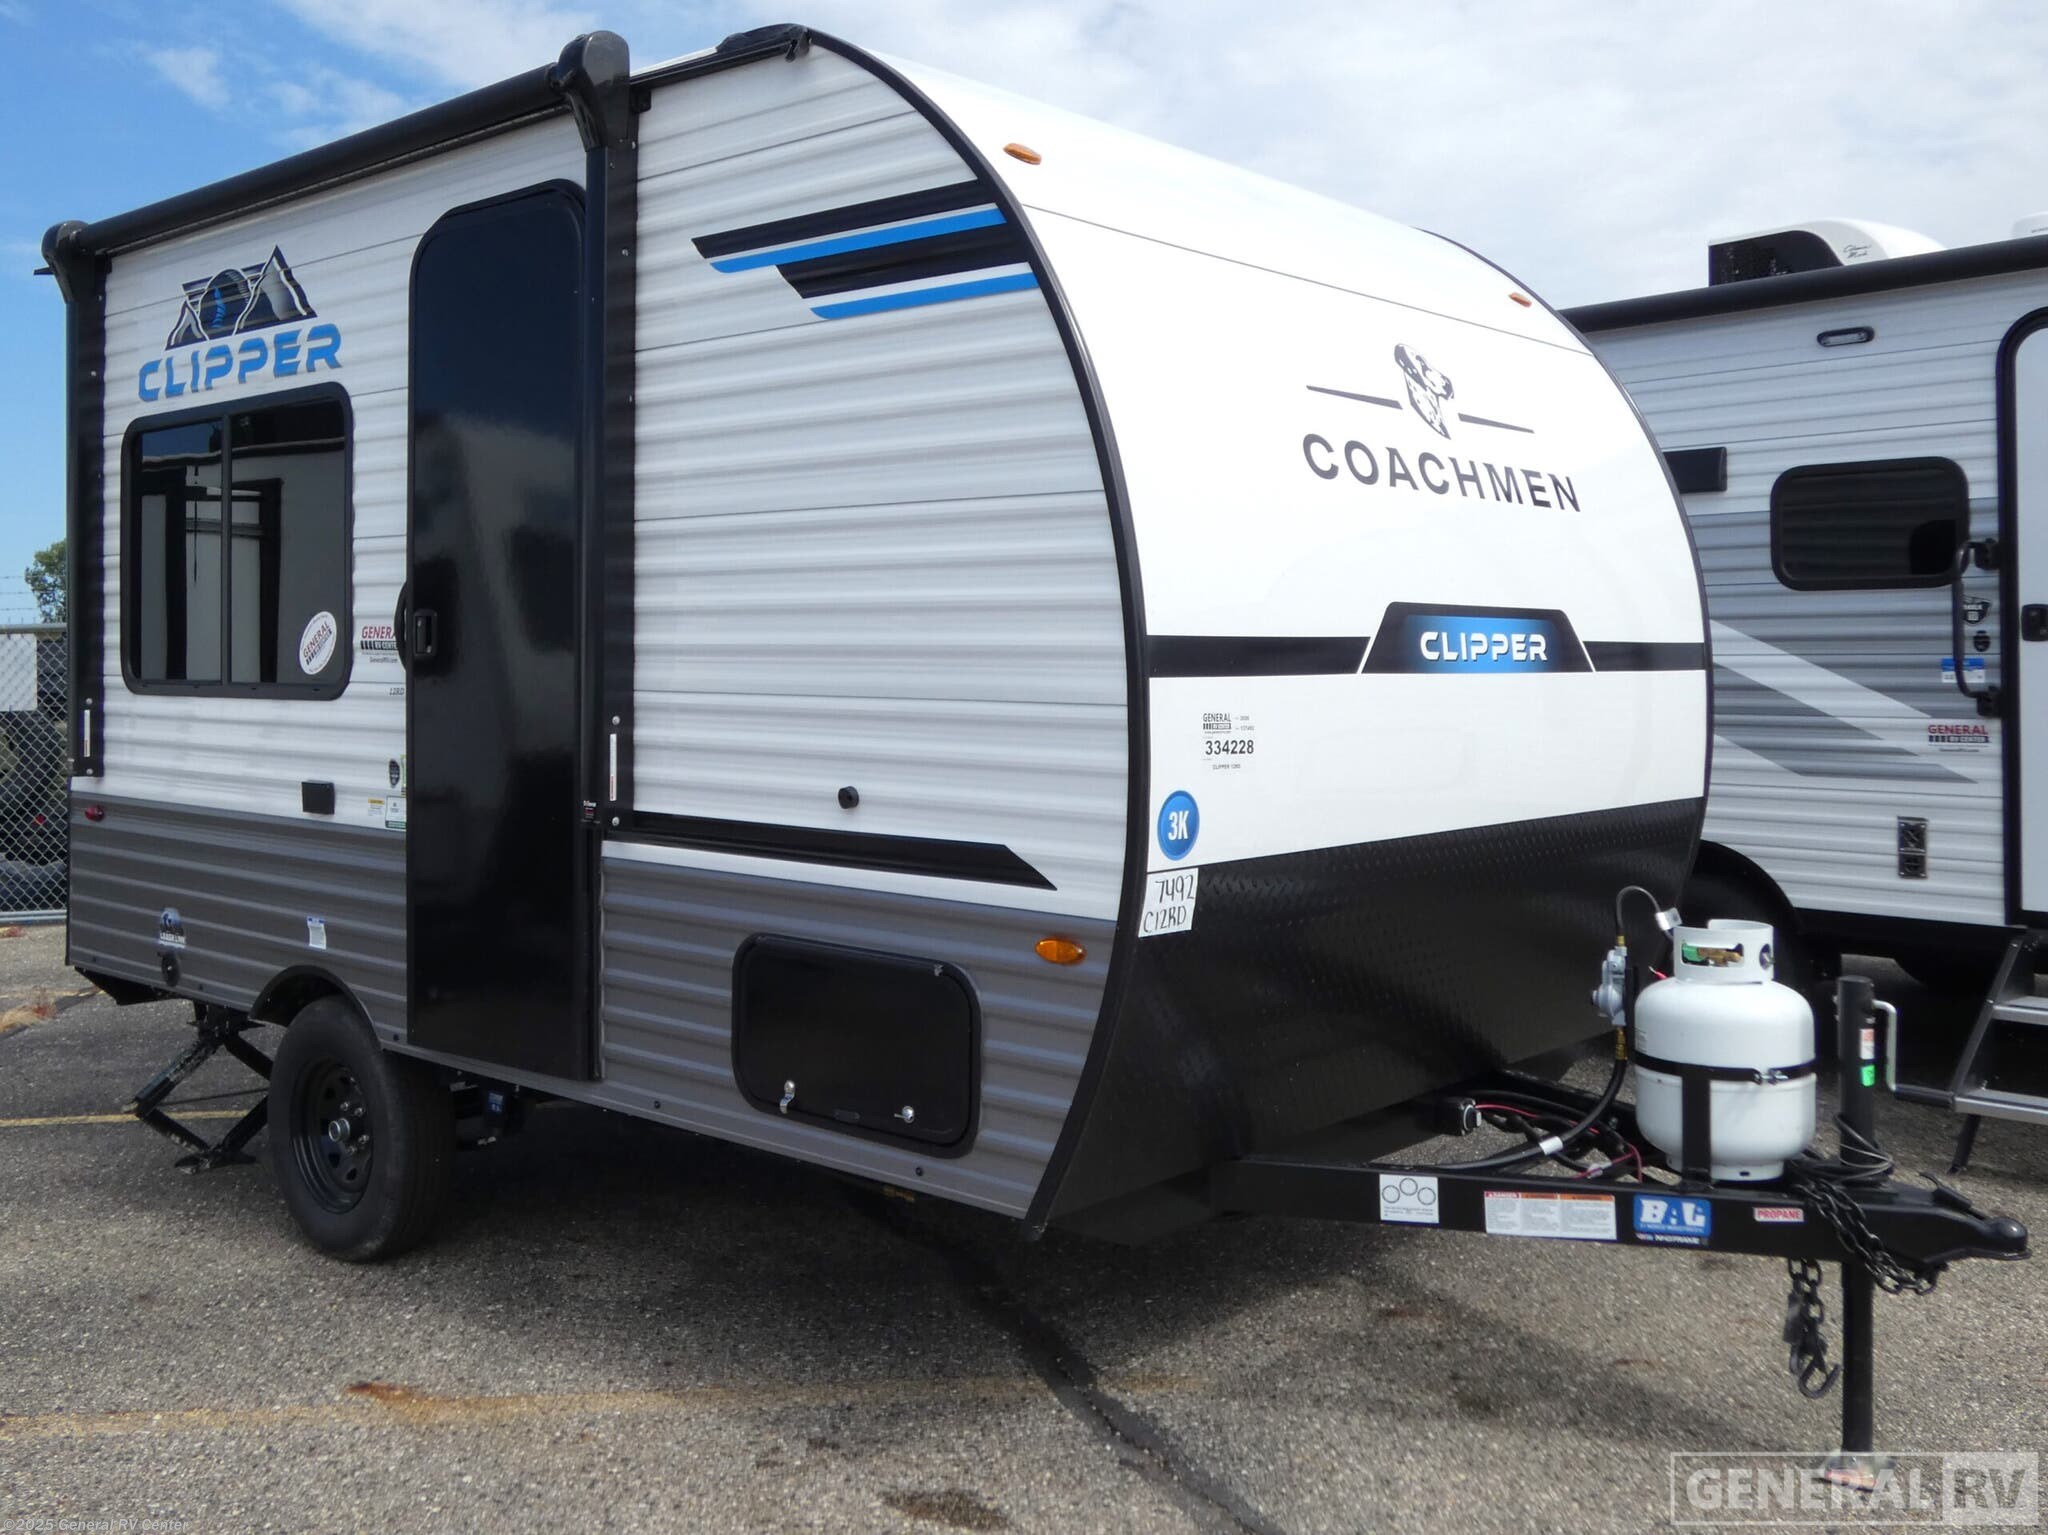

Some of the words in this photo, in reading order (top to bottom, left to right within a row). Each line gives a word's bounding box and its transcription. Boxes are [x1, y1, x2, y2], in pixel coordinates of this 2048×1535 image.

[138, 323, 343, 402] CLIPPER
[1302, 433, 1581, 513] COACHMEN
[303, 620, 330, 659] GENERAL
[1420, 631, 1548, 662] CLIPPER
[1203, 712, 1231, 722] GENERAL
[1928, 724, 1989, 735] GENERAL
[1205, 739, 1255, 755] 334228
[1167, 810, 1190, 841] 3K
[1155, 874, 1195, 904] 7492
[1757, 1209, 1800, 1220] PROPANE
